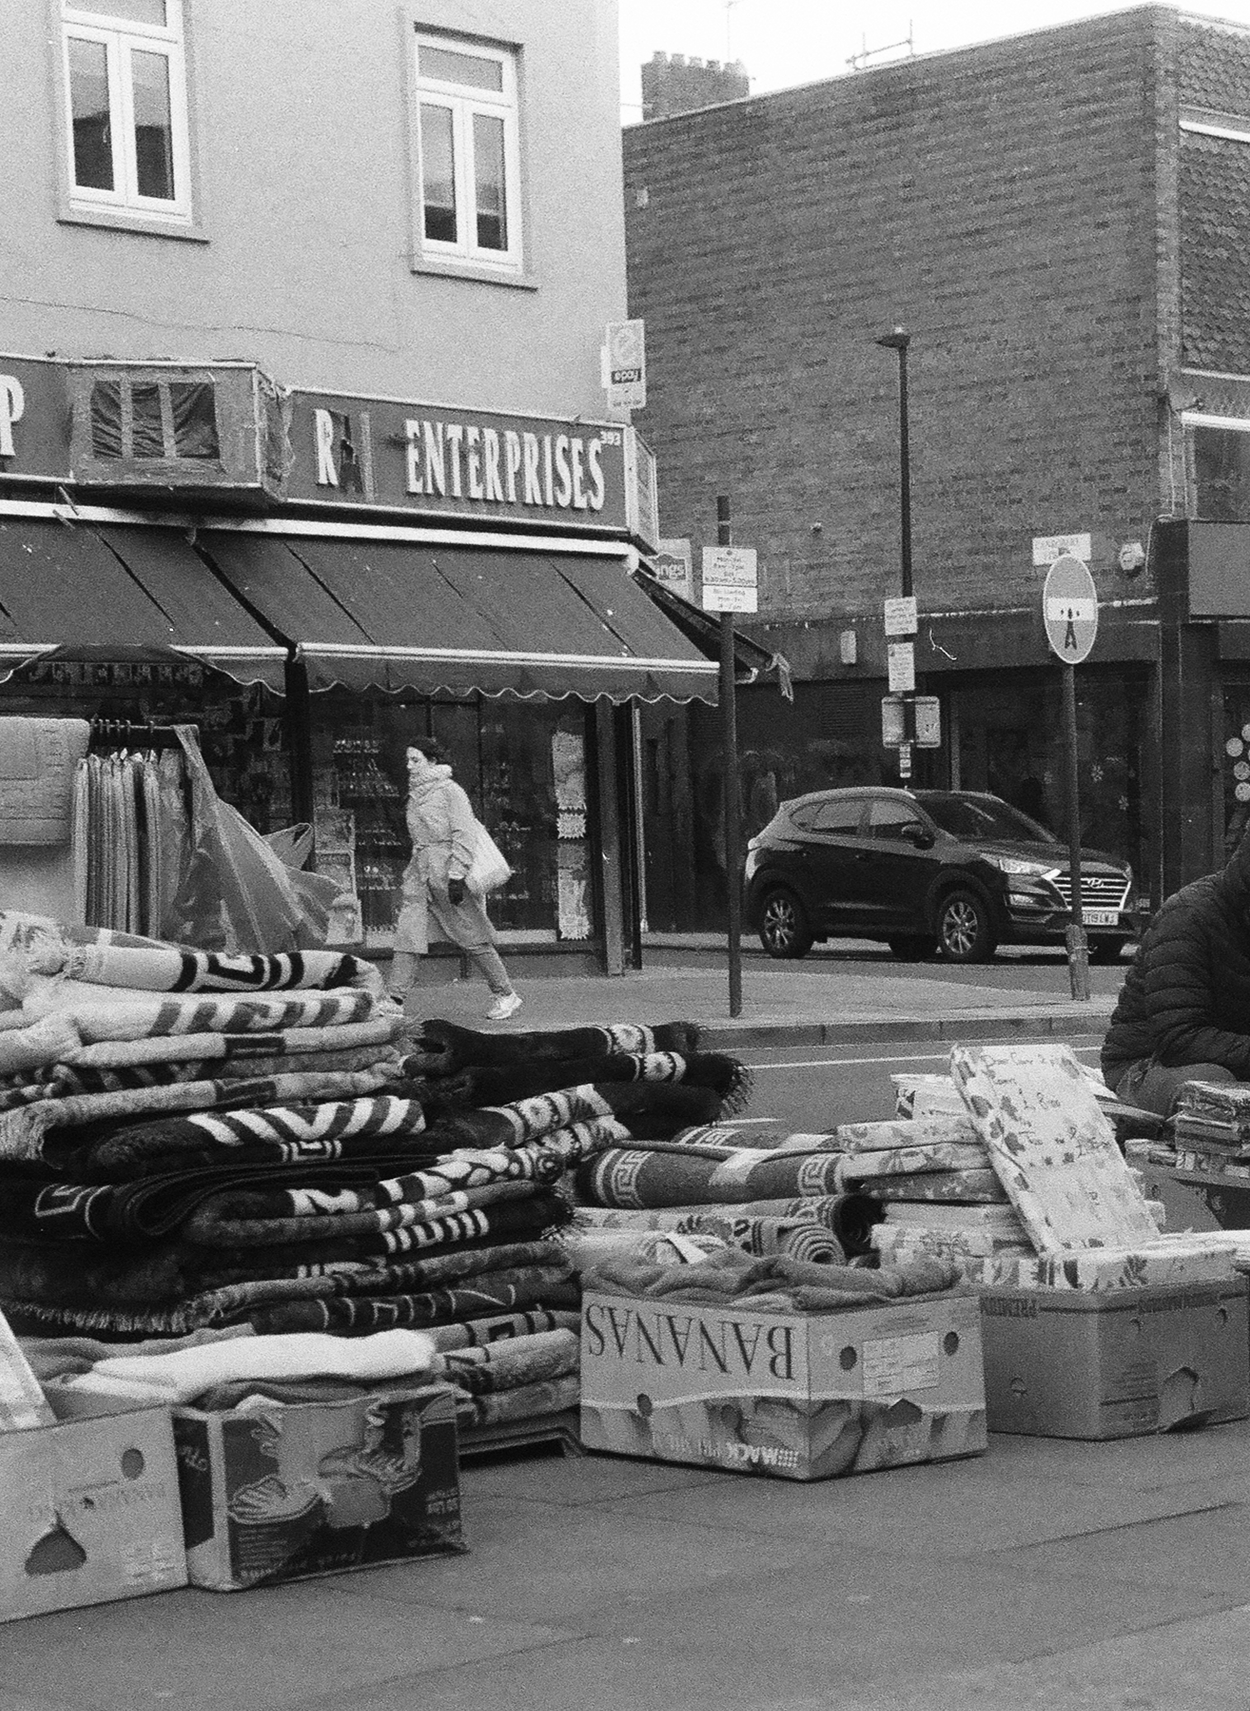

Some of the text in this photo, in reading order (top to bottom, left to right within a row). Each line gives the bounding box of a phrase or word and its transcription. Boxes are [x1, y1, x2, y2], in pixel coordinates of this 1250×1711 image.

[600, 431, 621, 446] 393
[405, 418, 606, 512] ENTERPRISES
[655, 560, 685, 581] ings
[583, 1303, 797, 1381] BANANAS
[726, 1442, 778, 1466] MACK
